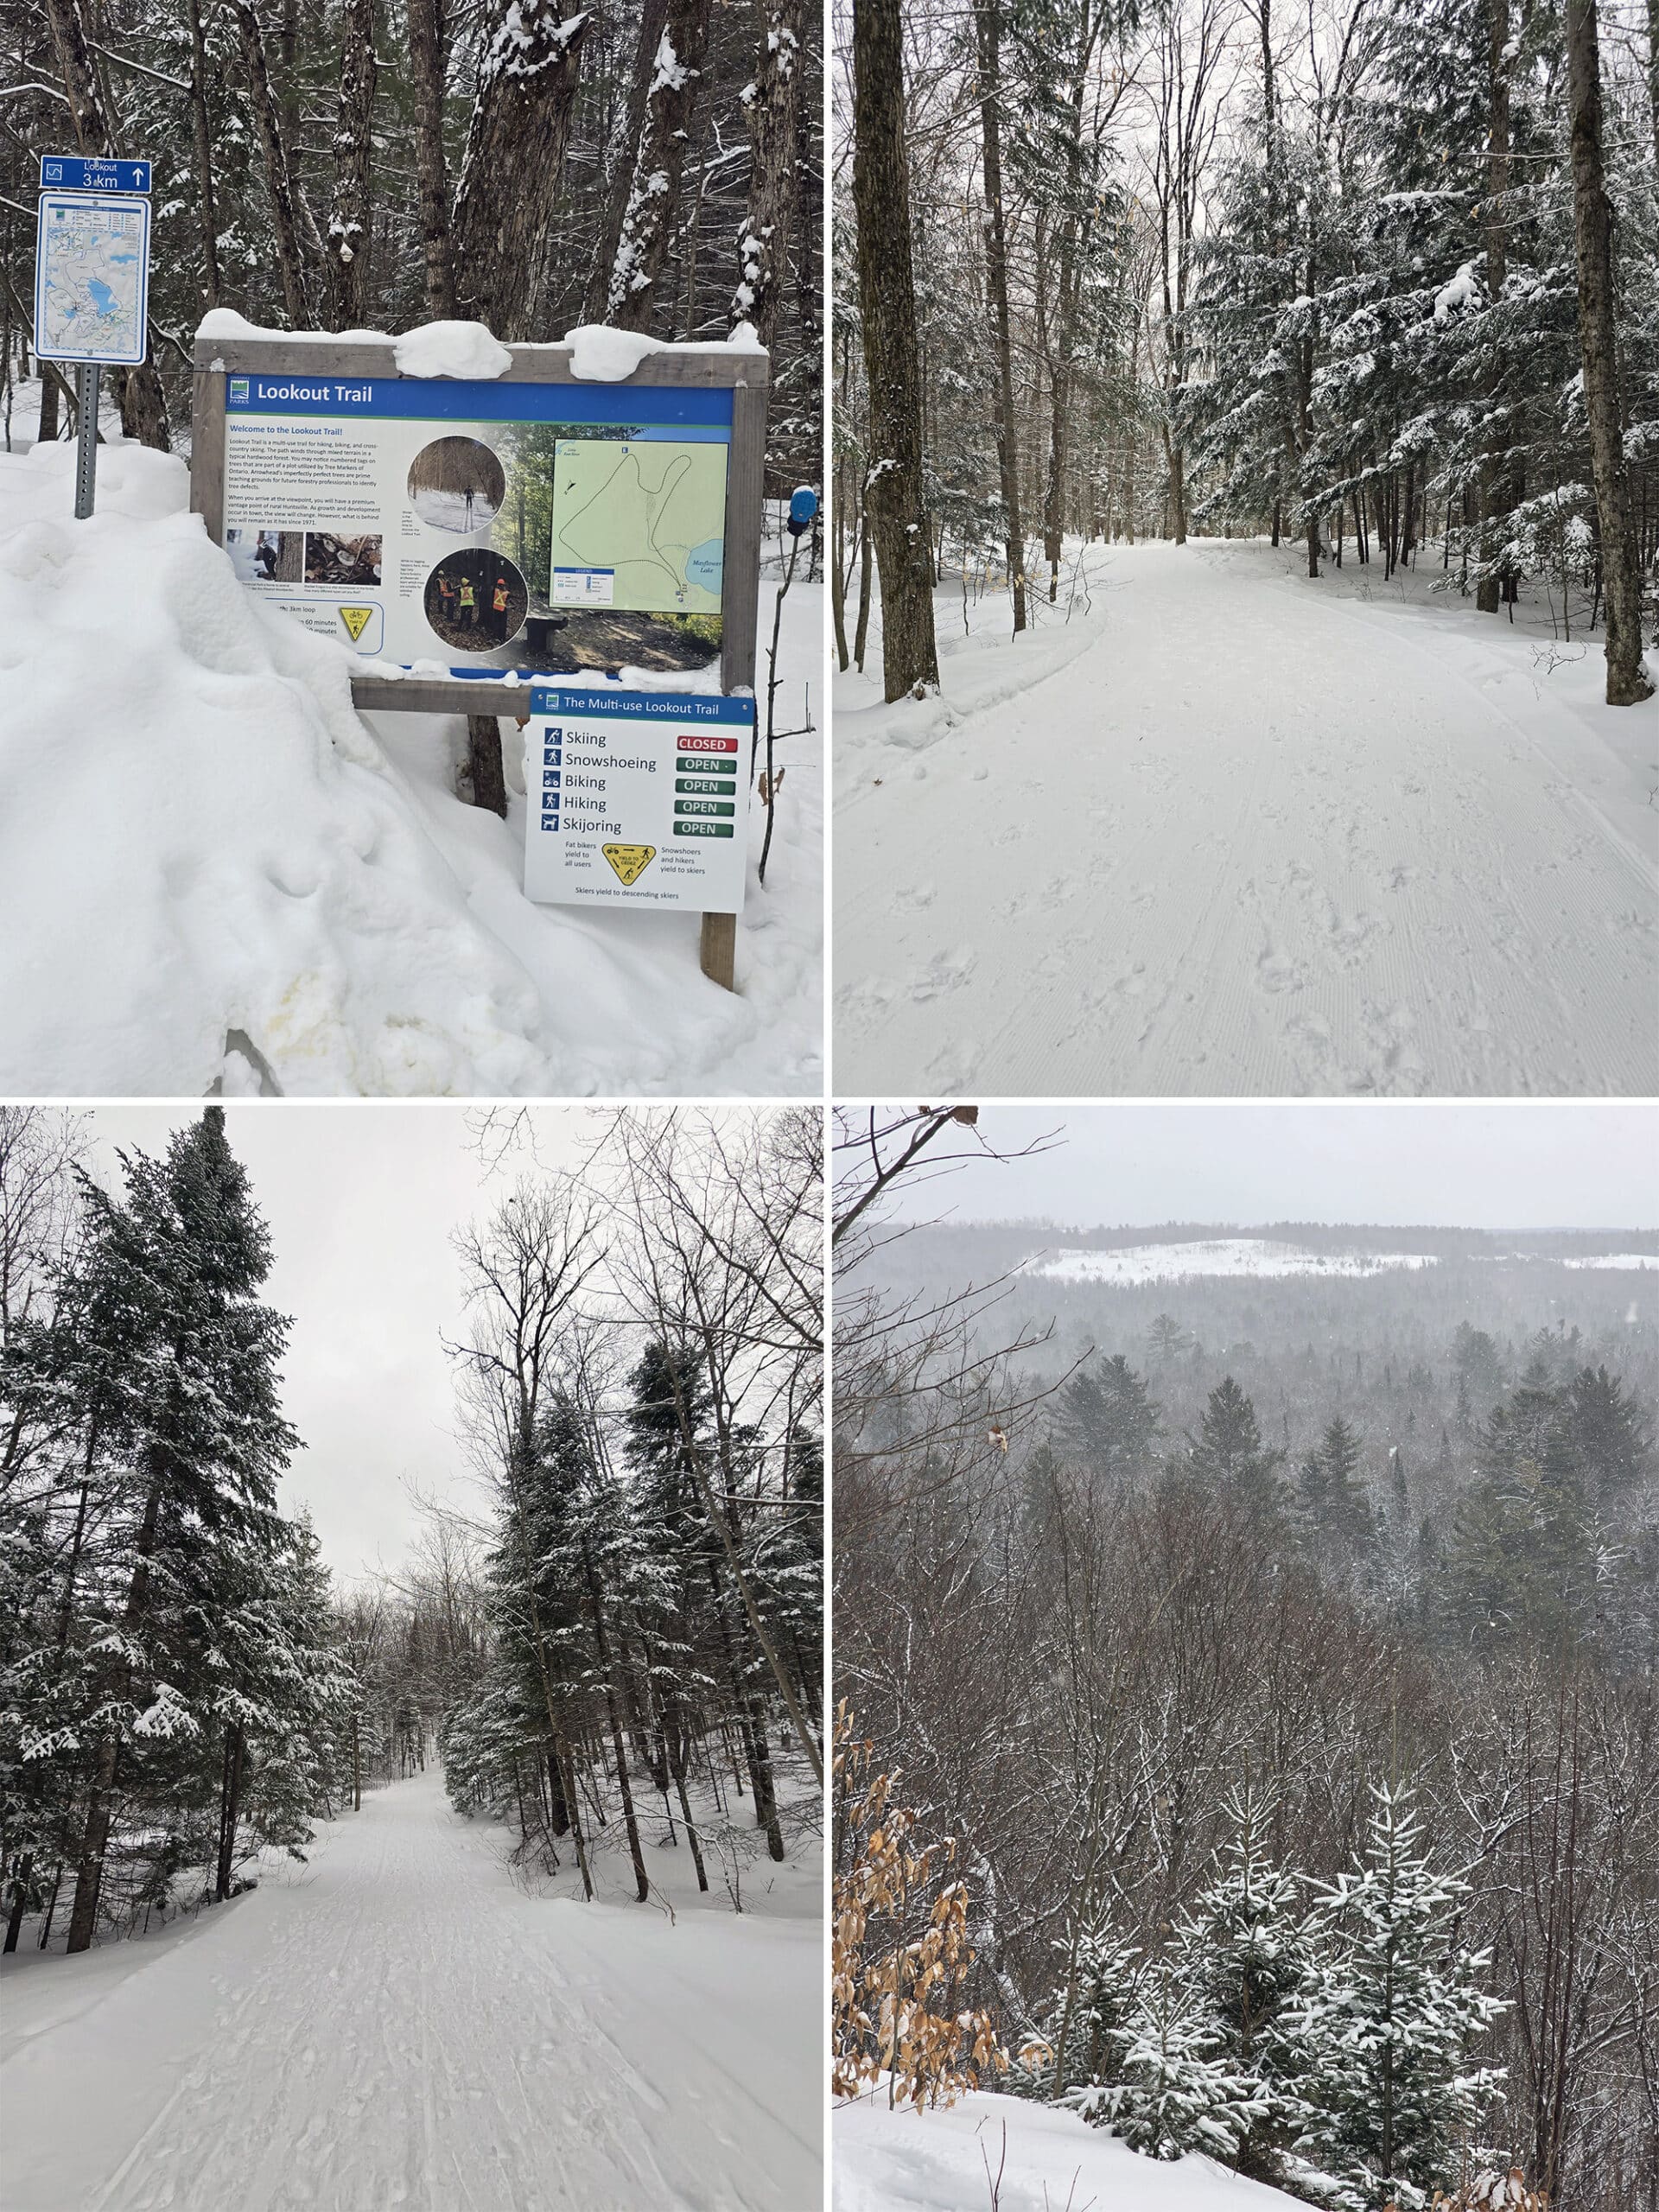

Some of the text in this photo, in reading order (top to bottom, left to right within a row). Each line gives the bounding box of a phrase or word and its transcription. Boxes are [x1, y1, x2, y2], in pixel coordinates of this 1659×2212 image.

[85, 162, 118, 172] Lookout
[83, 174, 118, 188] 3 km
[258, 384, 372, 402] Lookout Trail
[564, 697, 718, 715] The Multi-use Lookout Trail
[567, 732, 606, 747] Skiing
[679, 739, 726, 750] CLOSED
[565, 753, 657, 772] Snowshoeing
[685, 760, 719, 770] OPEN
[566, 775, 606, 791] Biking
[684, 780, 718, 791] OPEN
[565, 797, 607, 813] Hiking
[683, 802, 717, 813] OPEN
[563, 817, 621, 836] Skijoring
[682, 823, 715, 834] OPEN
[661, 847, 701, 855] Snowshoers
[622, 890, 658, 899] descending
